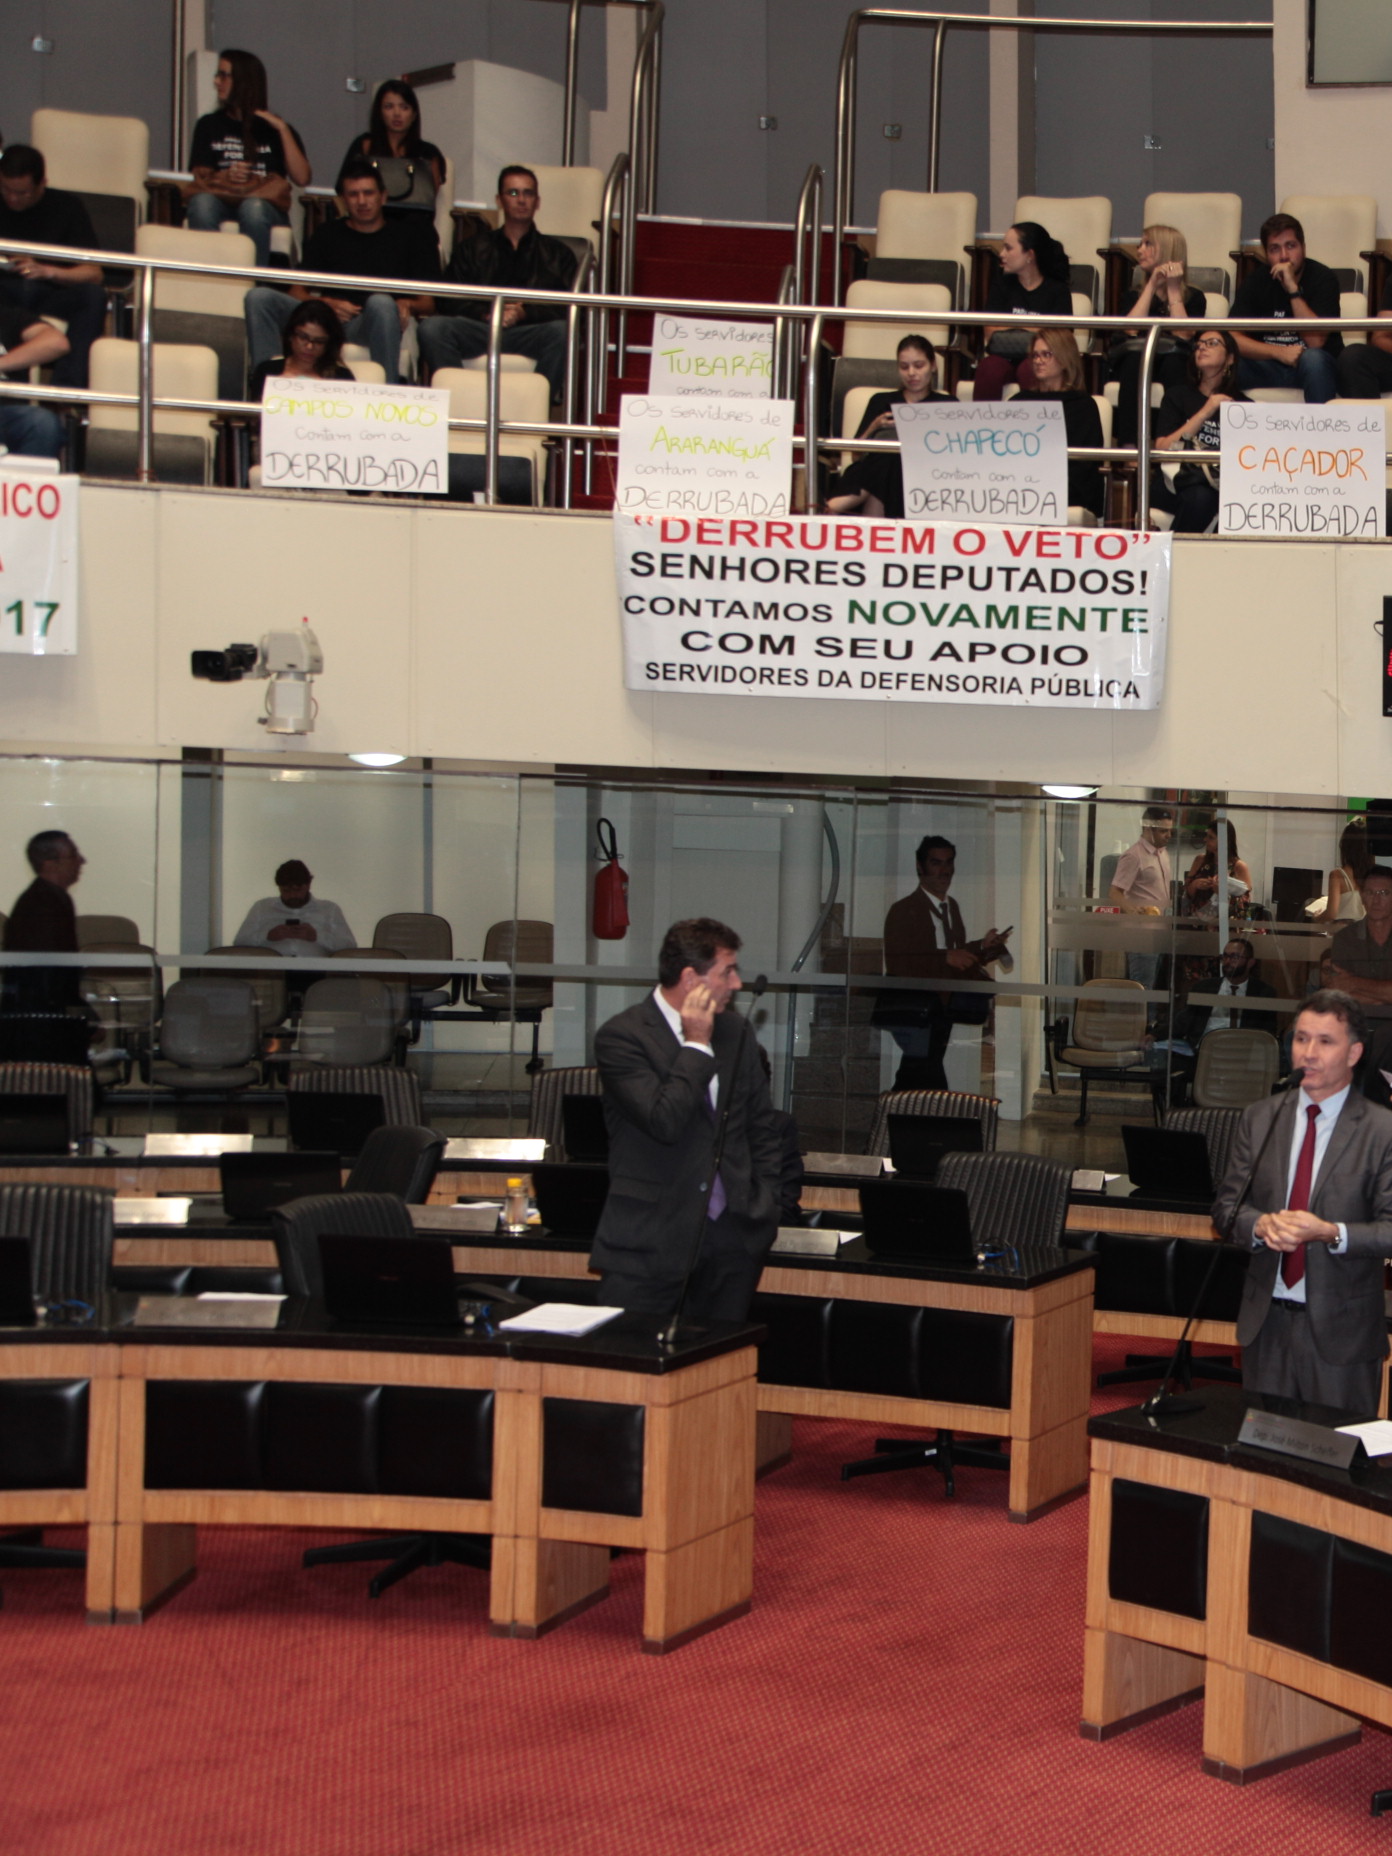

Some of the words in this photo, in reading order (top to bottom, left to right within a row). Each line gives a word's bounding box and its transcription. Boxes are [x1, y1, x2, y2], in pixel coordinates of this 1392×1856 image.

[661, 318, 688, 339] Os
[728, 387, 752, 398] com
[759, 390, 771, 398] a
[264, 395, 354, 418] CAMPOS
[365, 402, 438, 426] NOVOS
[627, 399, 663, 418] Os
[760, 410, 782, 428] de
[898, 405, 930, 422] Os
[1036, 407, 1062, 421] de
[1227, 404, 1258, 430] Os
[1357, 416, 1382, 433] de
[651, 425, 778, 463] ARARANGUÁ
[924, 423, 1046, 457] CHAPECÓ
[266, 451, 440, 490] DERRUBADA
[707, 466, 738, 478] com
[746, 470, 760, 480] a
[988, 472, 1016, 482] com
[1024, 474, 1040, 484] a
[1238, 445, 1368, 482] CAÇADOR
[619, 486, 786, 517] DERRUBADA
[908, 488, 1058, 518] DERRUBADA
[1250, 482, 1299, 496] contam
[1304, 486, 1329, 496] com
[1332, 487, 1346, 496] a
[1223, 502, 1378, 538] DERRUBADA
[952, 528, 987, 556] O
[630, 551, 867, 587] SENHORES
[882, 563, 1148, 597] DEPUTADOS!
[624, 595, 834, 624] CONTAMOS
[848, 599, 1149, 634] NOVAMENTE
[680, 630, 796, 656] COM
[814, 636, 914, 661] SEU
[928, 641, 1089, 667] APOIO
[646, 662, 808, 686] SERVIDORES
[818, 670, 852, 689] DA
[860, 672, 1024, 695] DEFENSORIA
[1030, 673, 1140, 699] PÚBLICA
